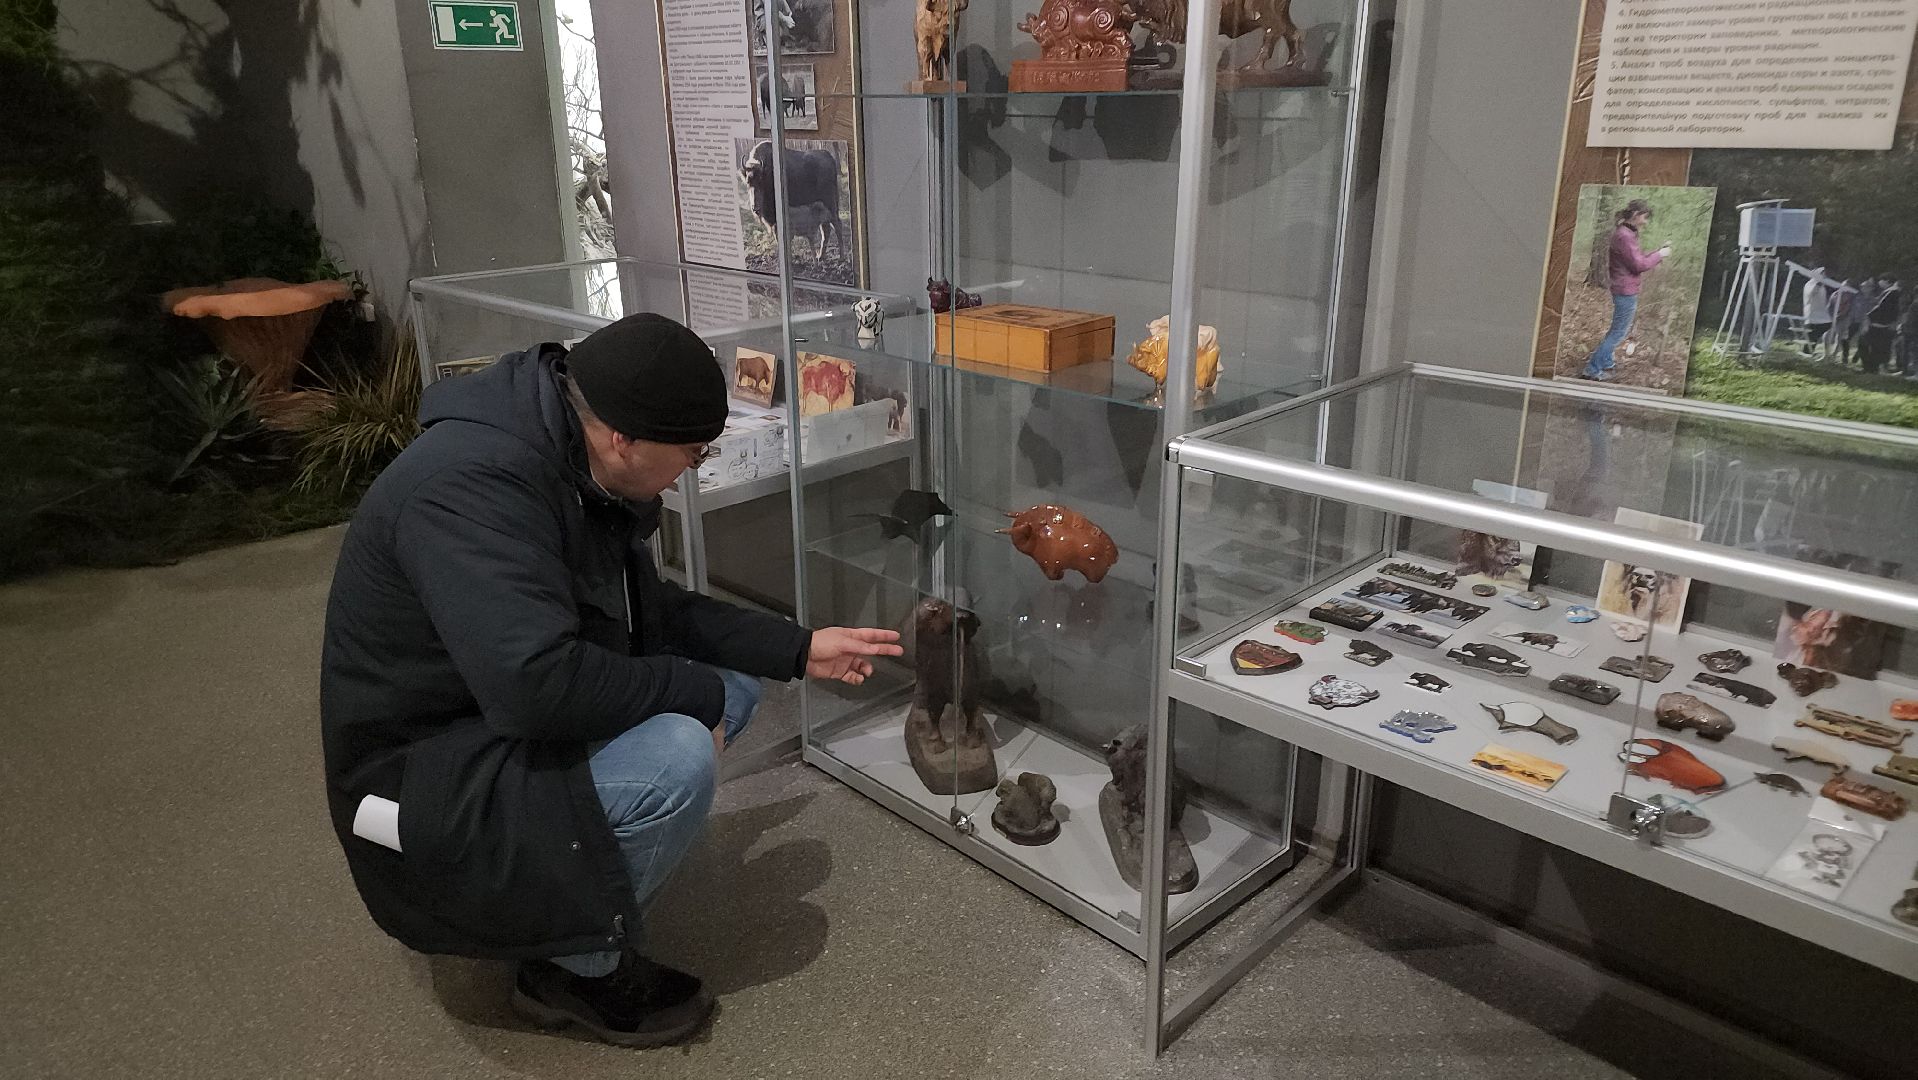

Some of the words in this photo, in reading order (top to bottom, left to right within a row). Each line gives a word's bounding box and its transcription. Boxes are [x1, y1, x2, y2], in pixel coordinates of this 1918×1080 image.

[1648, 33, 1707, 43] территории
[1790, 24, 1906, 36] метеорологические
[1621, 60, 1656, 69] Анализ
[1659, 58, 1684, 69] проб
[1687, 59, 1727, 69] воздуха
[1730, 57, 1751, 67] для
[1755, 55, 1829, 66] определения
[1628, 73, 1688, 82] взвешенных
[1638, 86, 1706, 95] консервацию
[1714, 85, 1751, 94] анализ
[1752, 82, 1779, 94] проб
[1846, 82, 1894, 92] осадков
[1603, 99, 1621, 108] для
[1625, 98, 1690, 108] определения
[1602, 112, 1688, 121] предварительную
[1691, 111, 1751, 121] подготовку
[1754, 109, 1782, 121] проб
[1785, 111, 1807, 121] для
[1816, 110, 1863, 119] анализа
[1873, 110, 1889, 119] их
[1608, 124, 1675, 134] региональной
